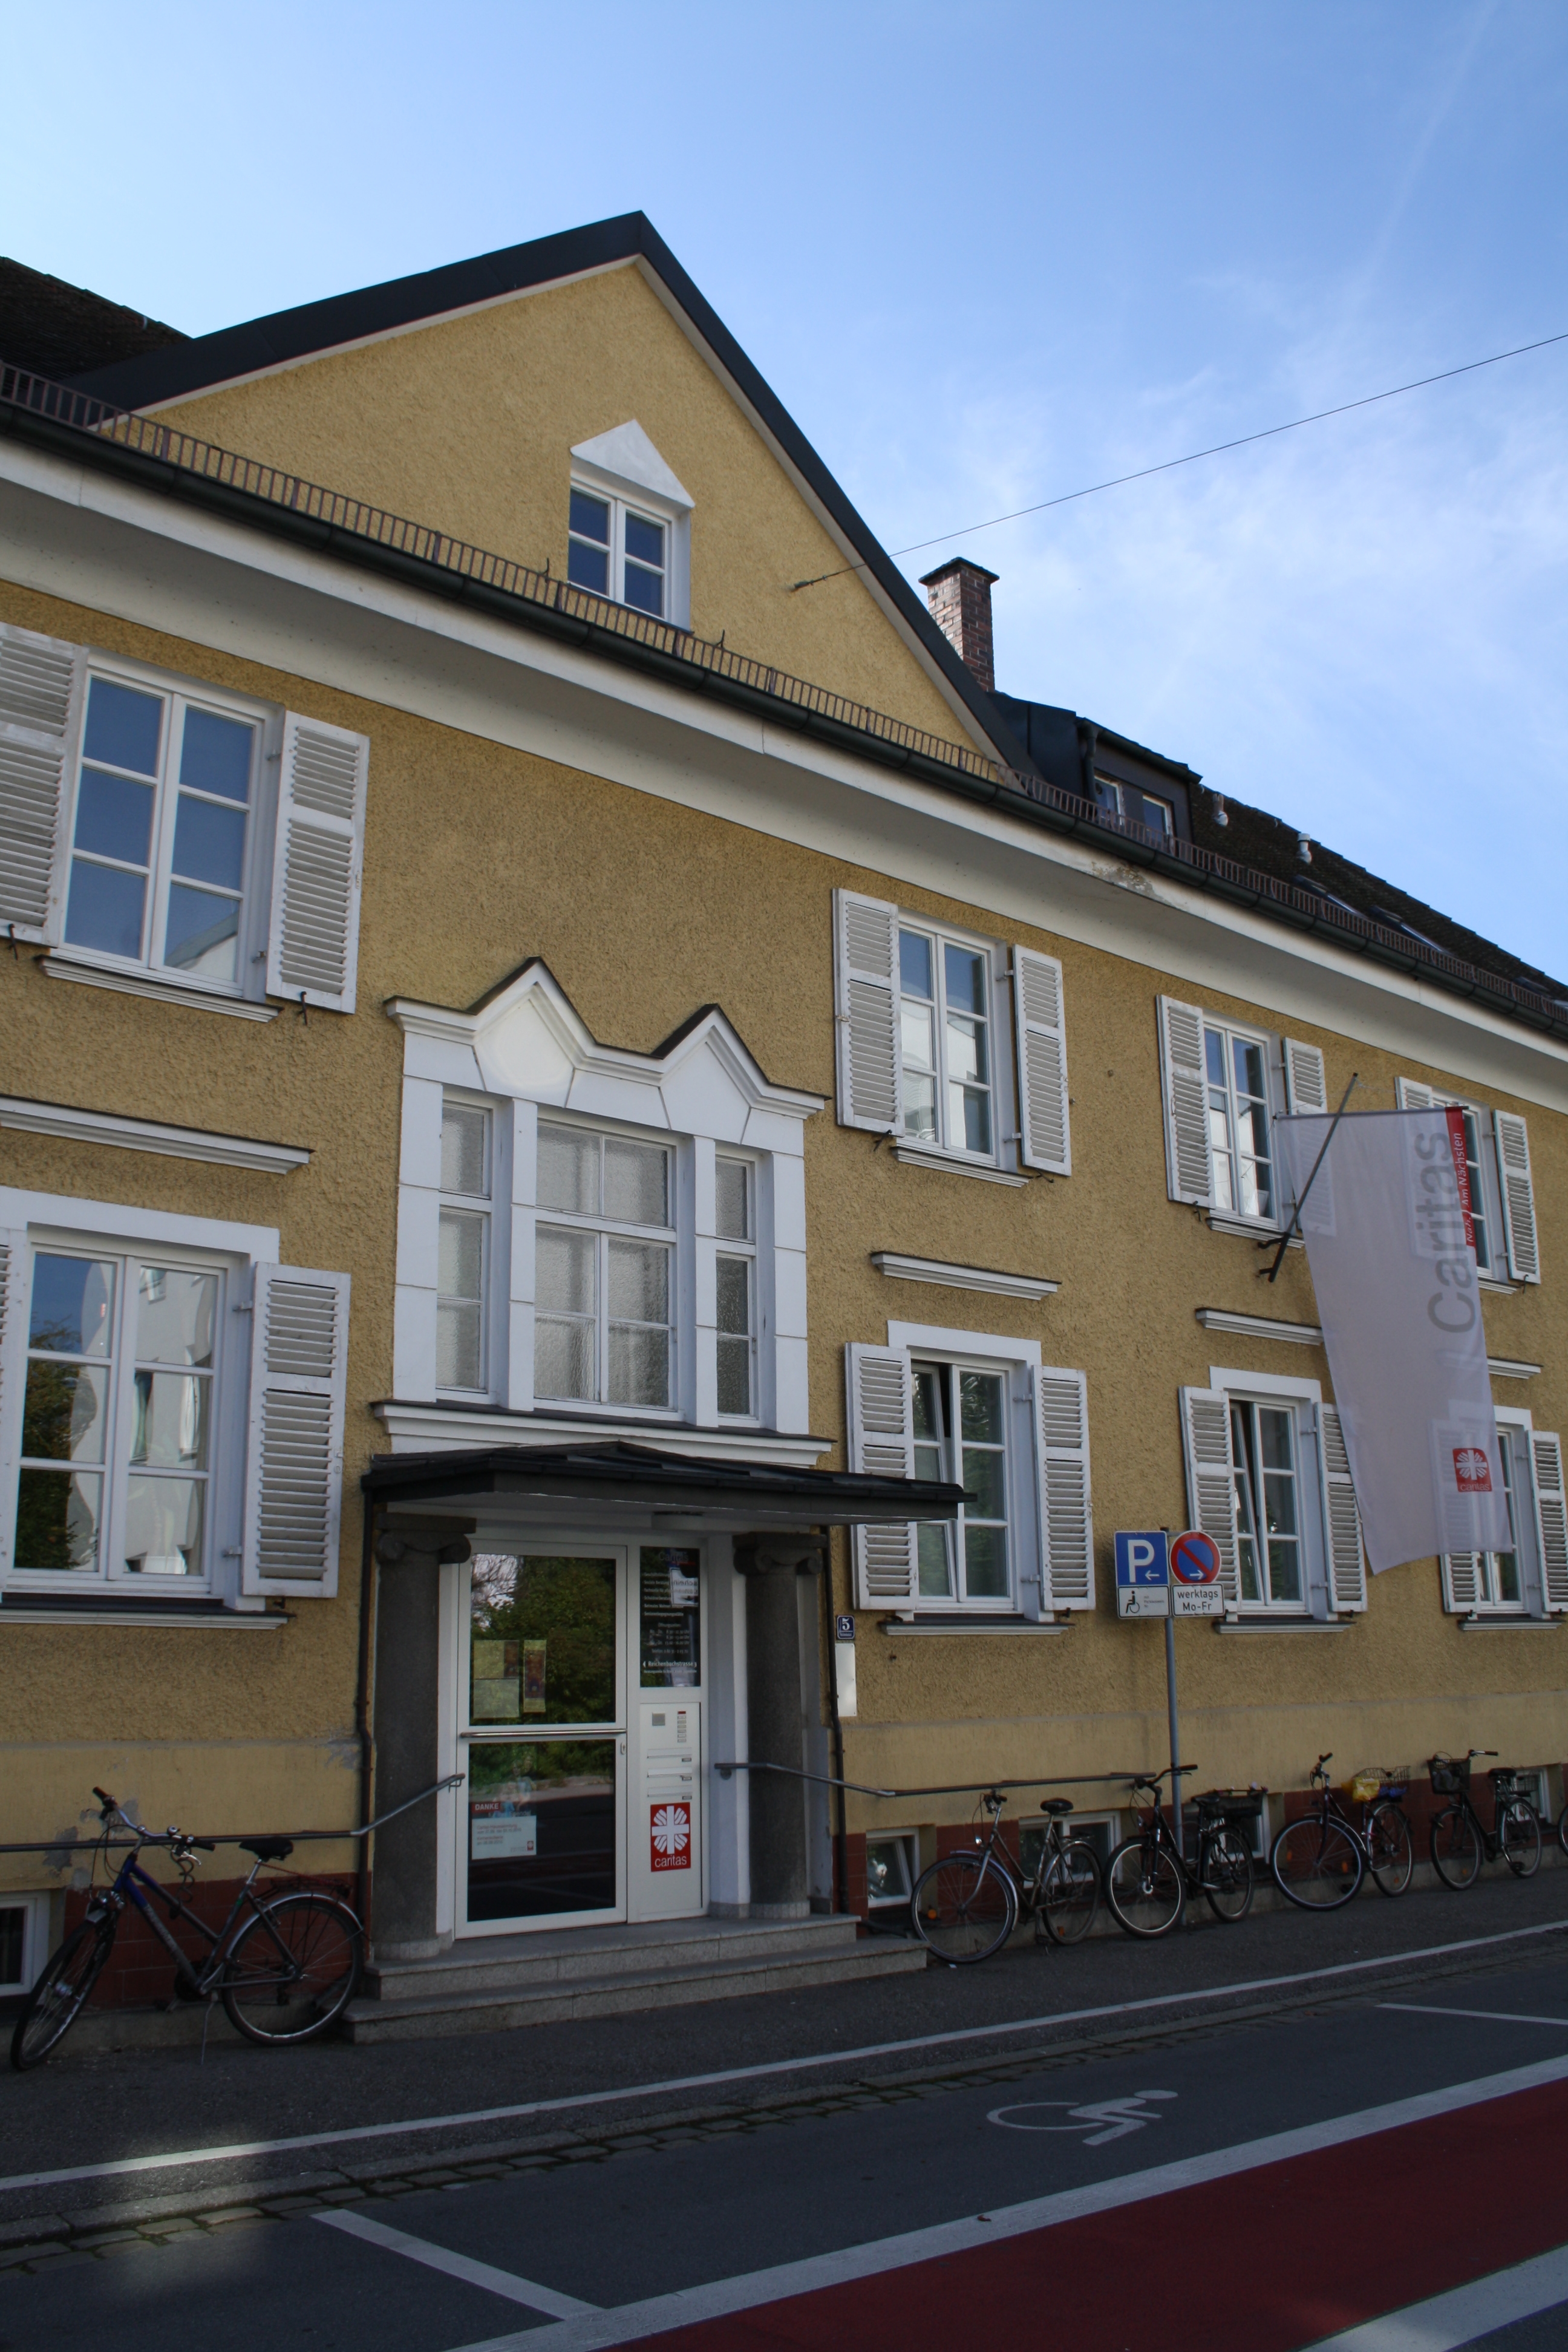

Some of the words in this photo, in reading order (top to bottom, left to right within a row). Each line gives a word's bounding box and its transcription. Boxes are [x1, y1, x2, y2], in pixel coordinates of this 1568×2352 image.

[1453, 1132, 1469, 1186] Nächsten
[1461, 1189, 1469, 1208] Am
[1416, 1132, 1477, 1334] Caritas
[1466, 1216, 1474, 1243] Nah.
[1460, 1482, 1490, 1492] caritas
[1127, 1539, 1155, 1583] P
[1177, 1589, 1219, 1599] werktags
[1183, 1601, 1212, 1612] Mo-Fr
[841, 1618, 851, 1630] 5
[655, 1855, 687, 1867] caritas
